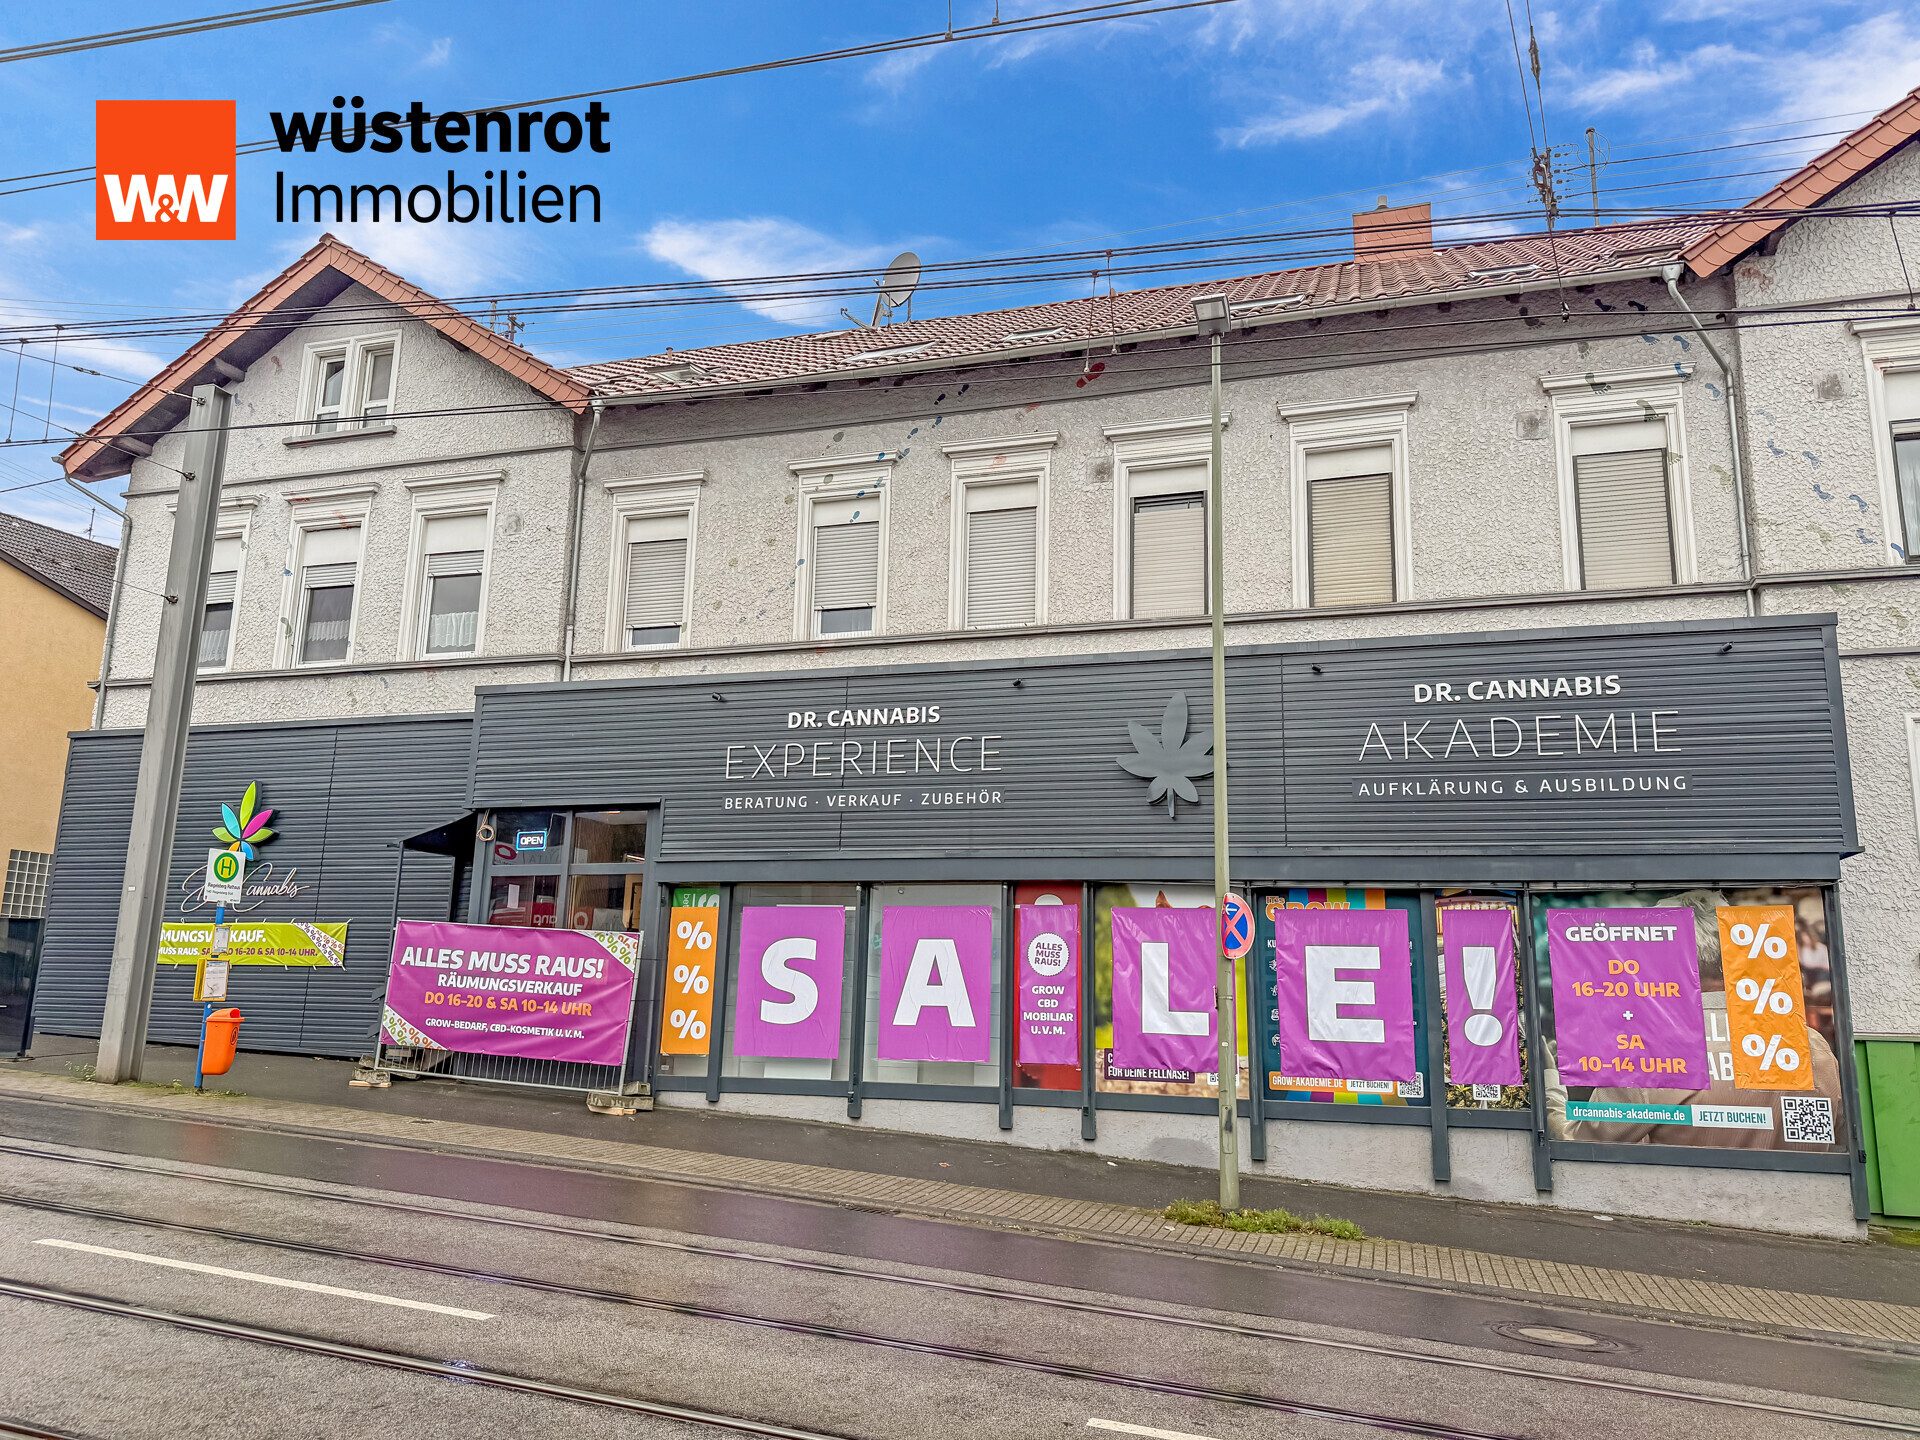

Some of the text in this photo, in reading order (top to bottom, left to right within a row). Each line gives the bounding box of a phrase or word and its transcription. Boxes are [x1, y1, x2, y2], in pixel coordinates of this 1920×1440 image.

[1414, 674, 1621, 703] DR. CANNABIS
[787, 705, 941, 729] DR. CANNABIS
[1358, 710, 1682, 762] AKADEMIE
[725, 735, 1002, 779] EXPERIENCE
[1358, 775, 1687, 797] AUFKLÄRUNG & AUSBILDUNG
[724, 795, 808, 810] BERATUNG
[826, 793, 902, 807] VERKAUF
[921, 789, 1002, 806] ZUBEHÖR
[520, 836, 543, 845] OPEN
[221, 859, 232, 876] H
[677, 921, 712, 950] %
[1565, 922, 1677, 942] GEÖFFNET
[1730, 923, 1788, 959] %
[264, 948, 275, 956] SA
[298, 948, 318, 957] UHR.
[1035, 941, 1063, 951] ALLES
[1035, 949, 1061, 959] MUSS
[400, 946, 605, 979] ALLES MUSS RAUS!
[1034, 957, 1061, 967] RAUS!
[1608, 959, 1640, 975] DO
[437, 972, 583, 996] RÄUMUNGSVERKAUF
[673, 964, 709, 994] %
[1031, 985, 1065, 995] GROW
[1571, 981, 1681, 998] 16-20 UHR
[1735, 978, 1793, 1015] %
[424, 991, 592, 1017] DO 16-20 & SA 10-14 UHR
[1037, 999, 1059, 1008] CBD
[670, 1009, 706, 1040] %
[1023, 1012, 1074, 1022] MOBILIAR
[425, 1017, 489, 1032] GROW-BEDARF,
[489, 1022, 554, 1037] CBD-KOSMETIK
[1030, 1025, 1066, 1035] U.V.M.
[1616, 1034, 1645, 1050] SA
[1741, 1033, 1800, 1072] %
[1124, 1068, 1147, 1078] DEINE
[1148, 1068, 1190, 1080] FELLNASE!
[1578, 1056, 1688, 1074] 10-14 UHR
[1272, 1075, 1390, 1090] GROW-AKADEMIE.DE JETZT BUCHEN!
[1572, 1106, 1767, 1124] drcannabis-akademie.de JETZT BUCHEN!
